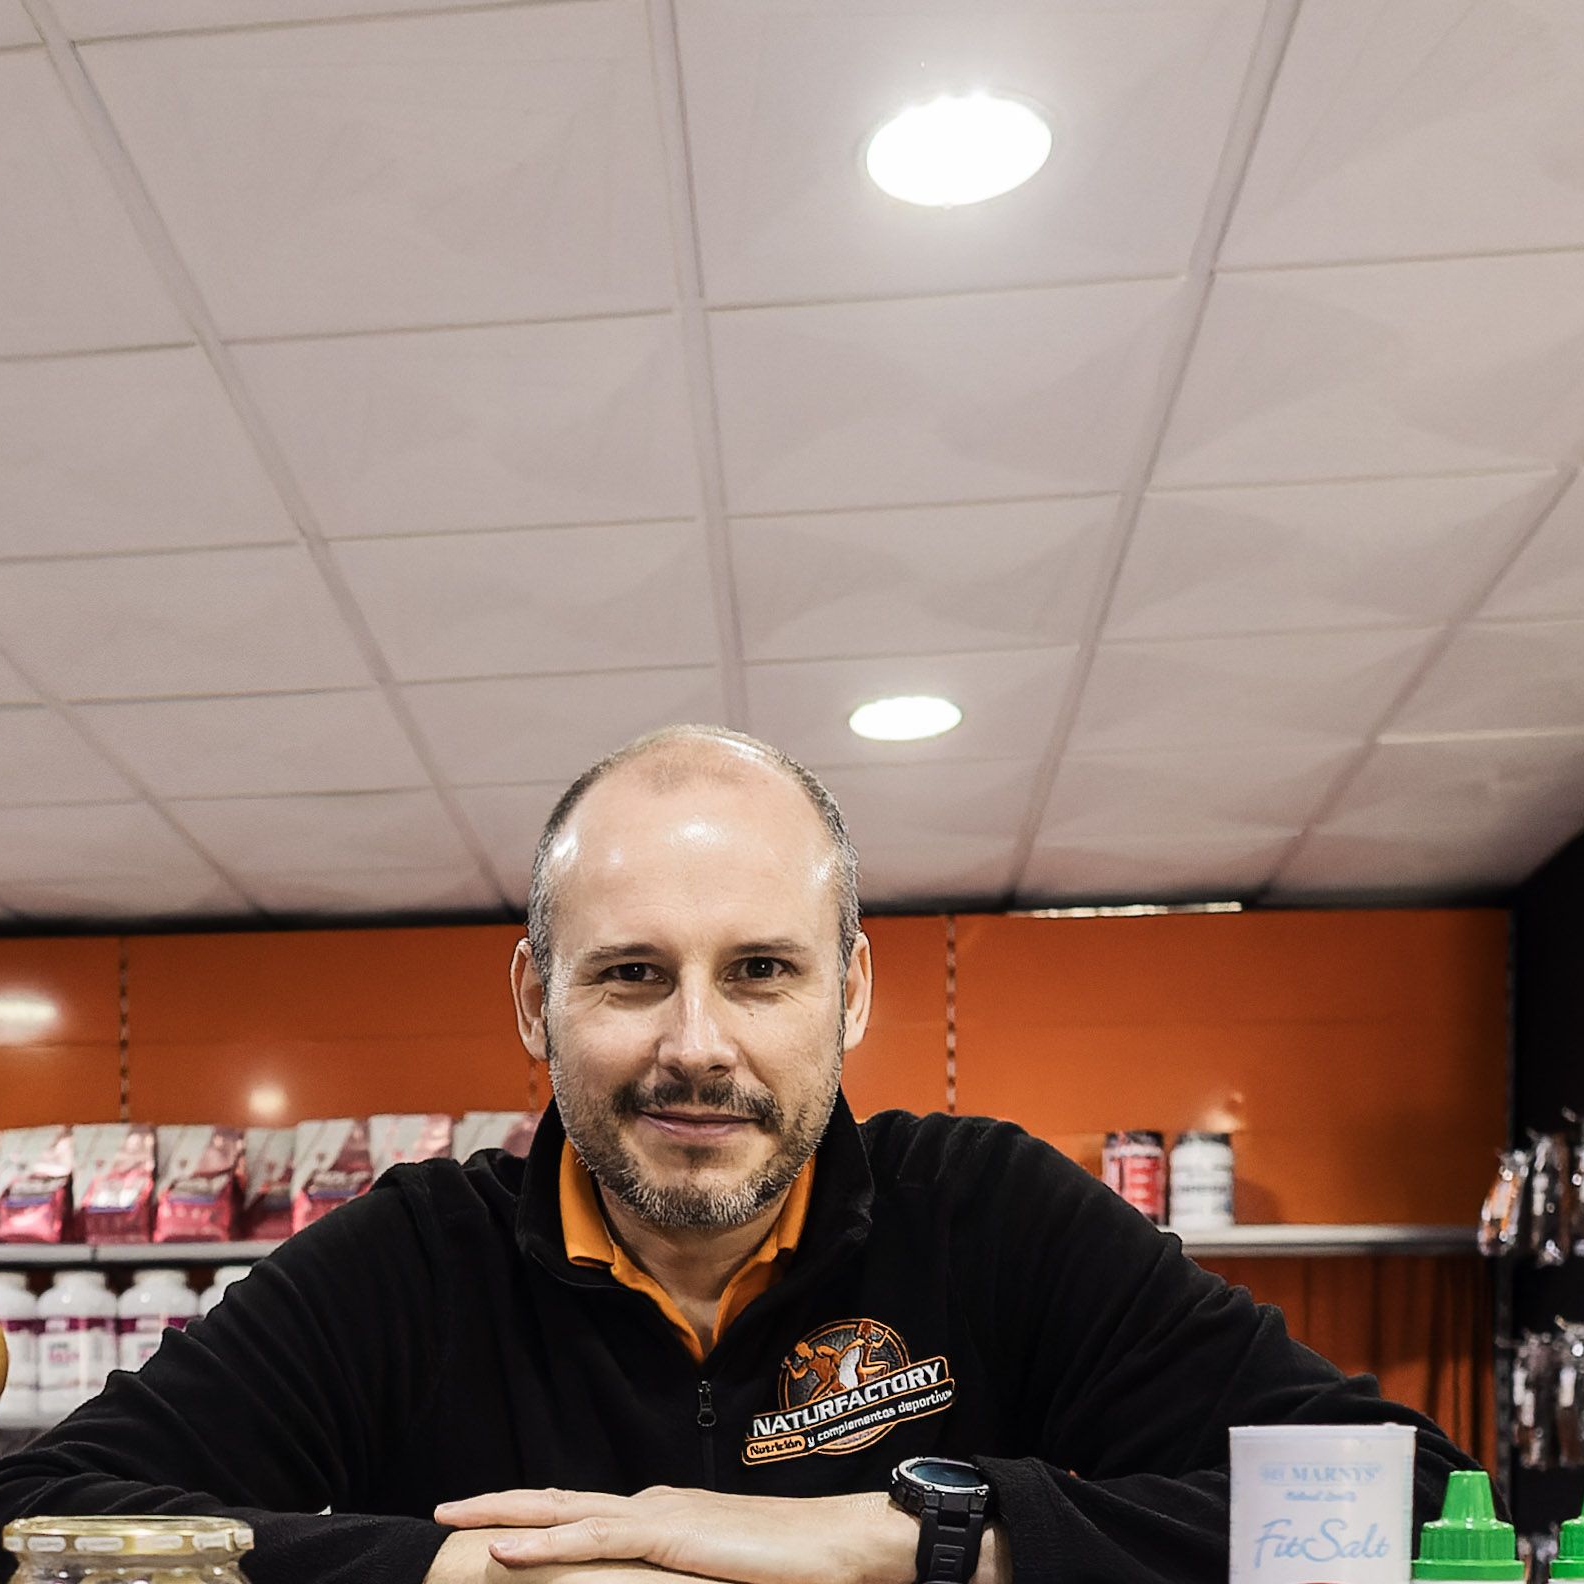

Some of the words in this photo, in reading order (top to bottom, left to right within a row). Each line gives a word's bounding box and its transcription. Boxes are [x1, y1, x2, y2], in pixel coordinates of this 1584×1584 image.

[753, 1362, 941, 1438] NATURFACTORY
[807, 1437, 815, 1448] y
[817, 1407, 896, 1443] complementos
